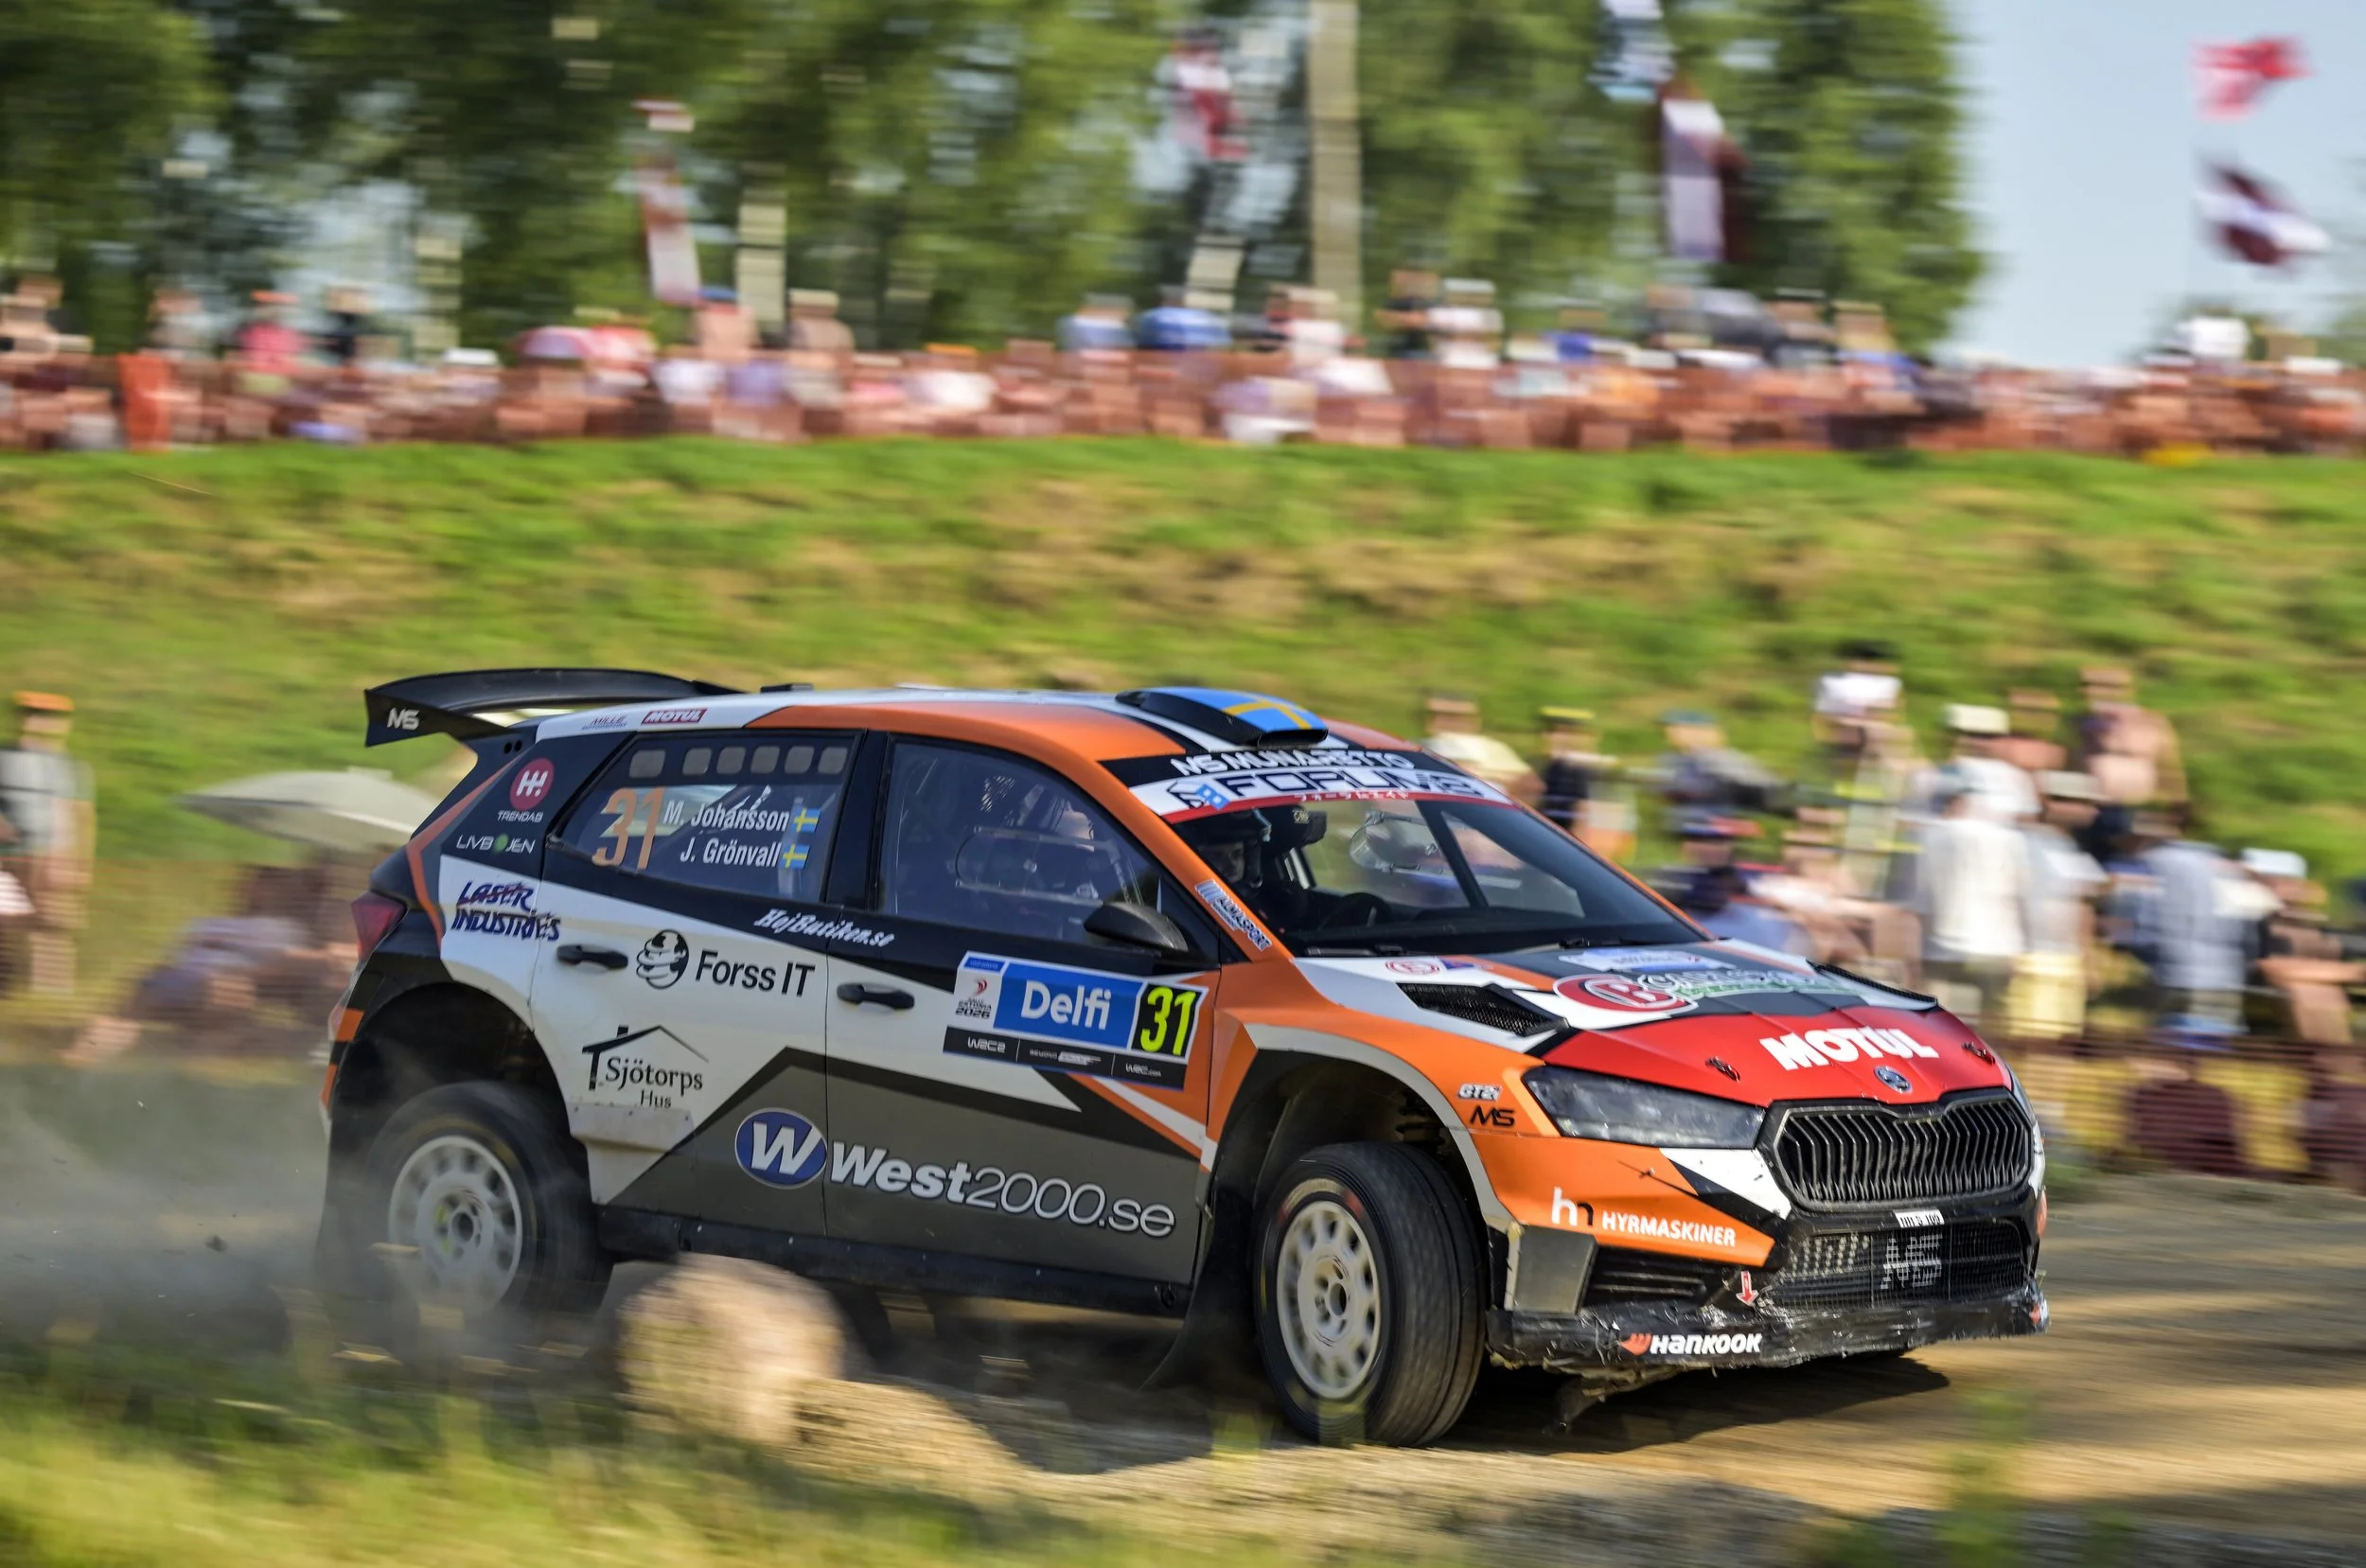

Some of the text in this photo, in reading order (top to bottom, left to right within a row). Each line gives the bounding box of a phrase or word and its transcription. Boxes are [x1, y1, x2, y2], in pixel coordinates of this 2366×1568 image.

[387, 707, 420, 731] MS
[646, 710, 703, 723] MOTUL
[1170, 754, 1228, 776] MS
[592, 786, 665, 871] 31
[663, 800, 790, 832] M. Johansson
[680, 837, 784, 868] J. Grönvall
[696, 948, 816, 997] Forss IT
[1020, 979, 1112, 1031] Delfi
[1139, 986, 1197, 1057] 31
[1758, 1025, 1940, 1071] MOTUL
[605, 1056, 703, 1098] Sjötorps
[640, 1089, 673, 1109] Hus
[1469, 1104, 1516, 1127] MS
[829, 1140, 1176, 1238] West2000.se
[1601, 1210, 1737, 1247] HYRMASKINER
